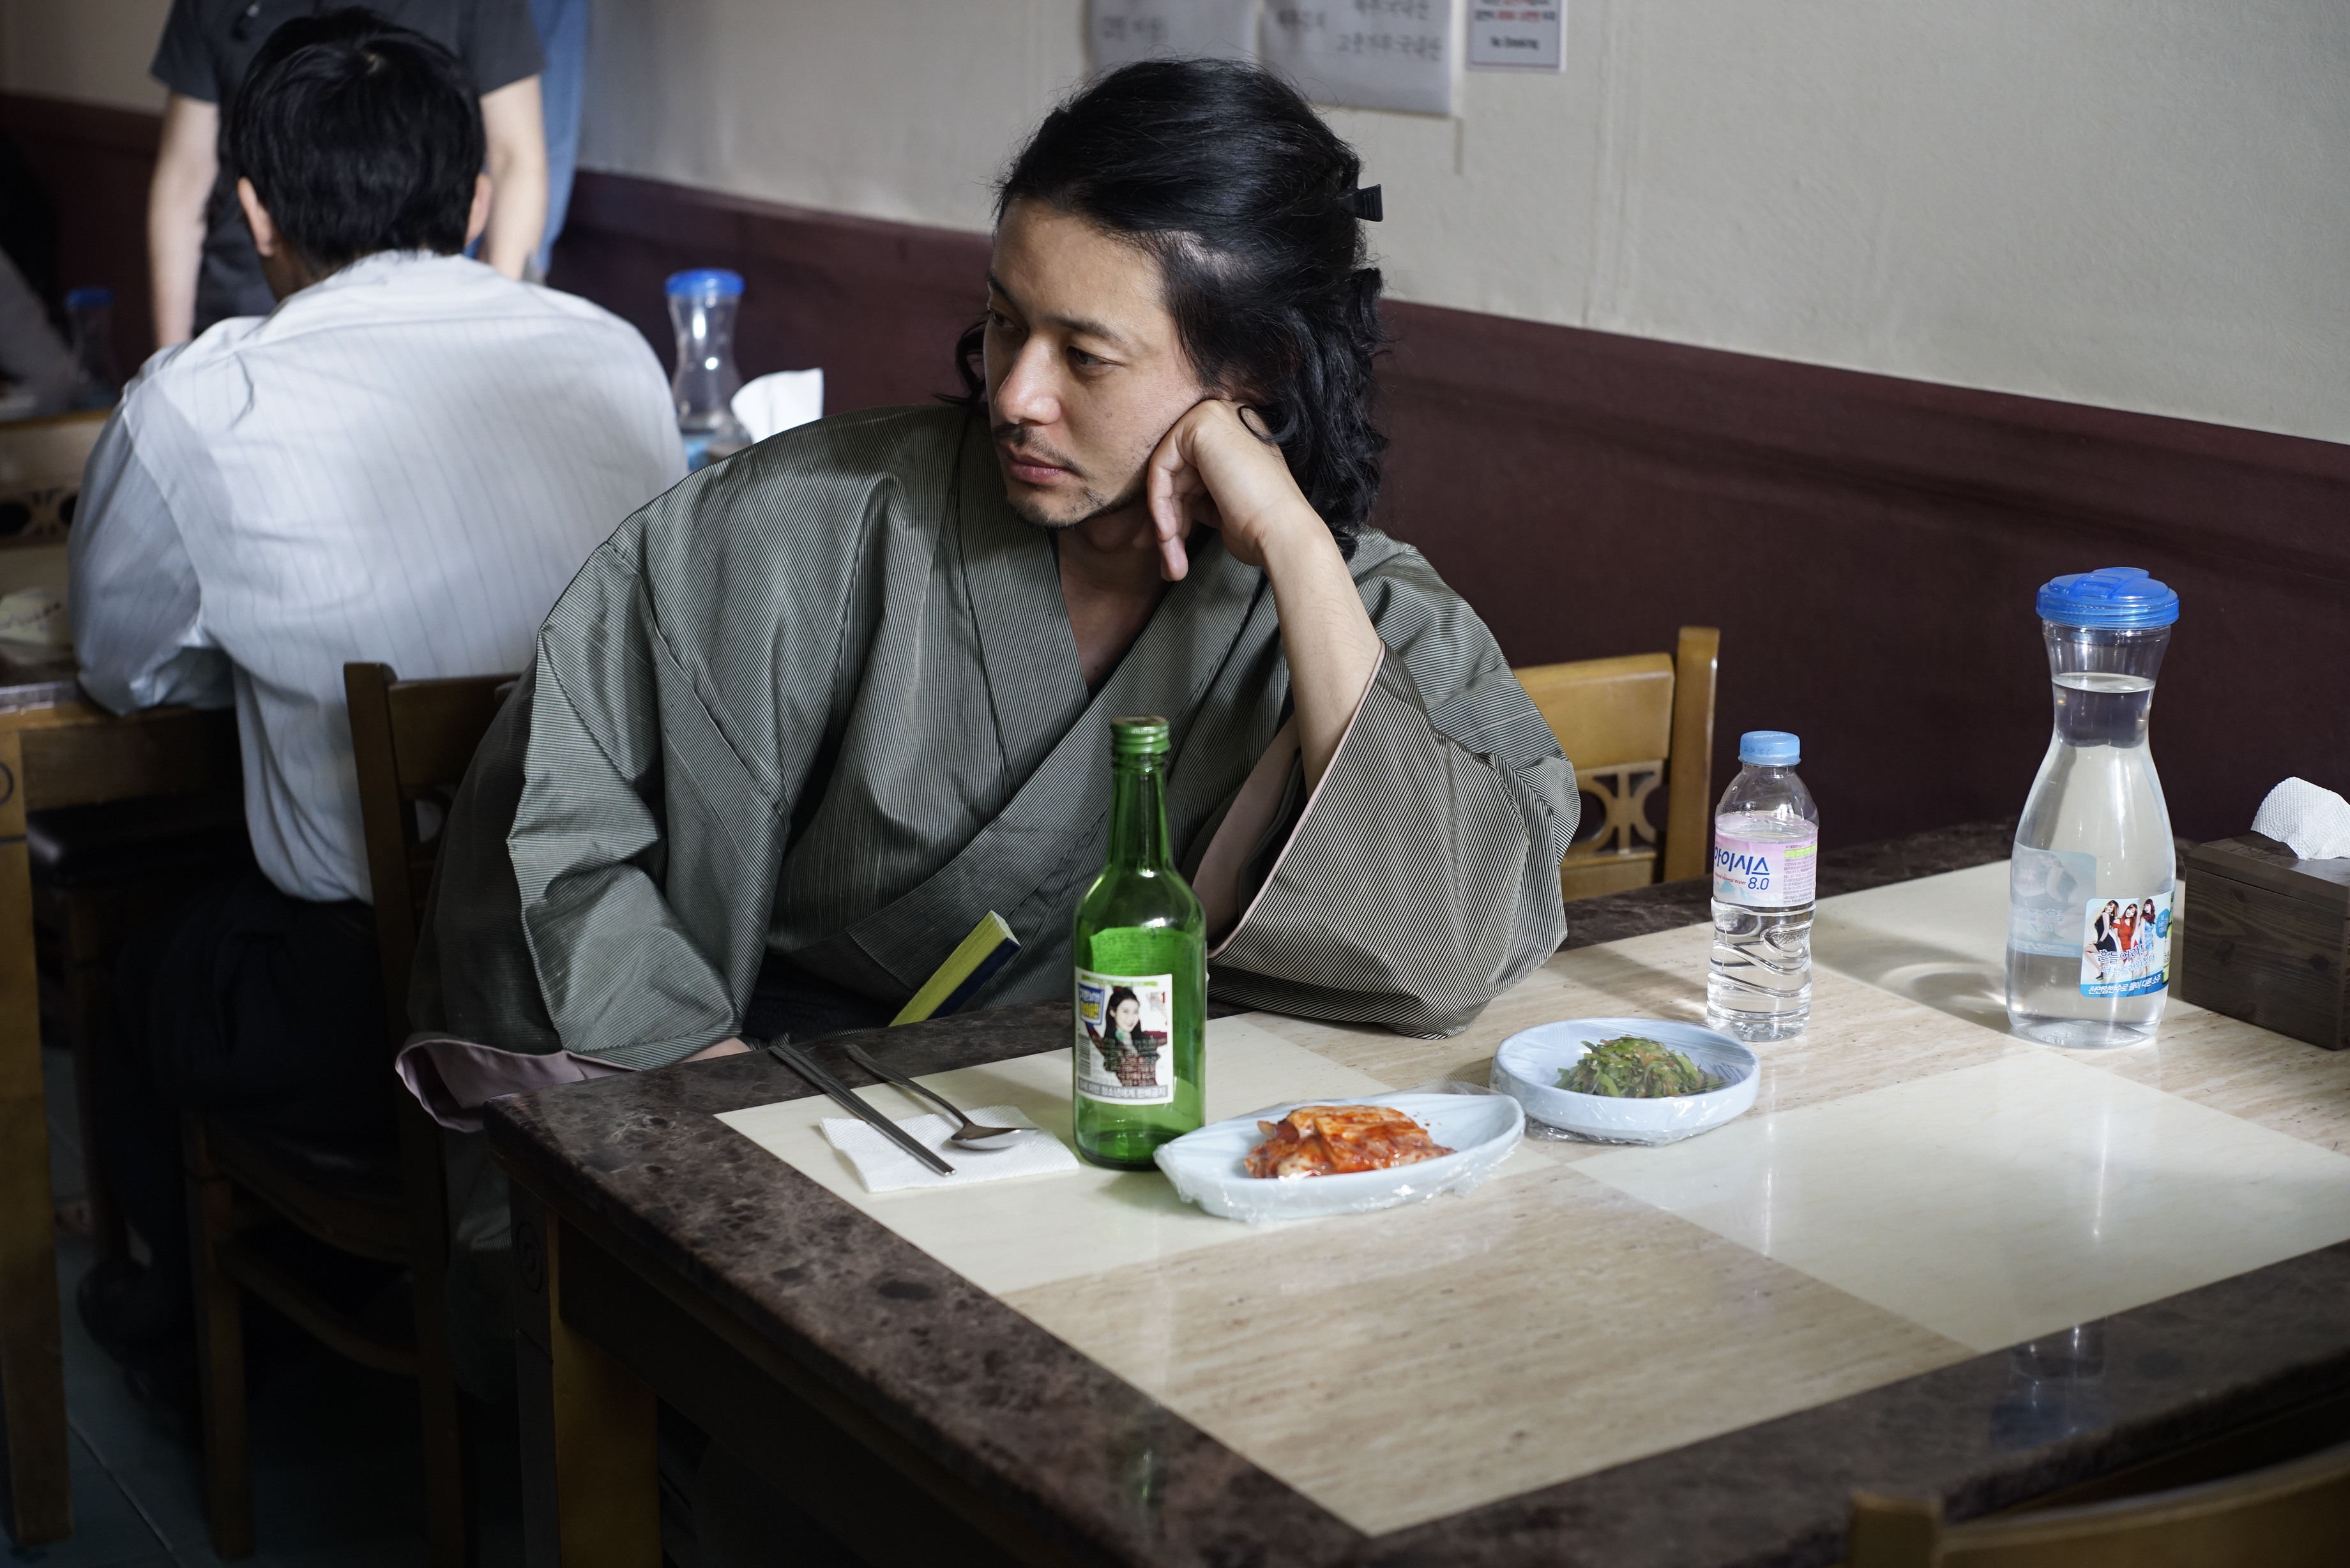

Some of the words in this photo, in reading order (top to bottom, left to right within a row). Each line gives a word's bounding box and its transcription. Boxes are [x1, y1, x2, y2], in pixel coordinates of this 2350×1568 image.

[1715, 846, 1770, 875] 아이시스
[1748, 877, 1770, 890] 8.0
[2097, 944, 2144, 964] 흔들어라!
[2102, 965, 2111, 977] 더
[2113, 954, 2155, 976] 부드러워진다
